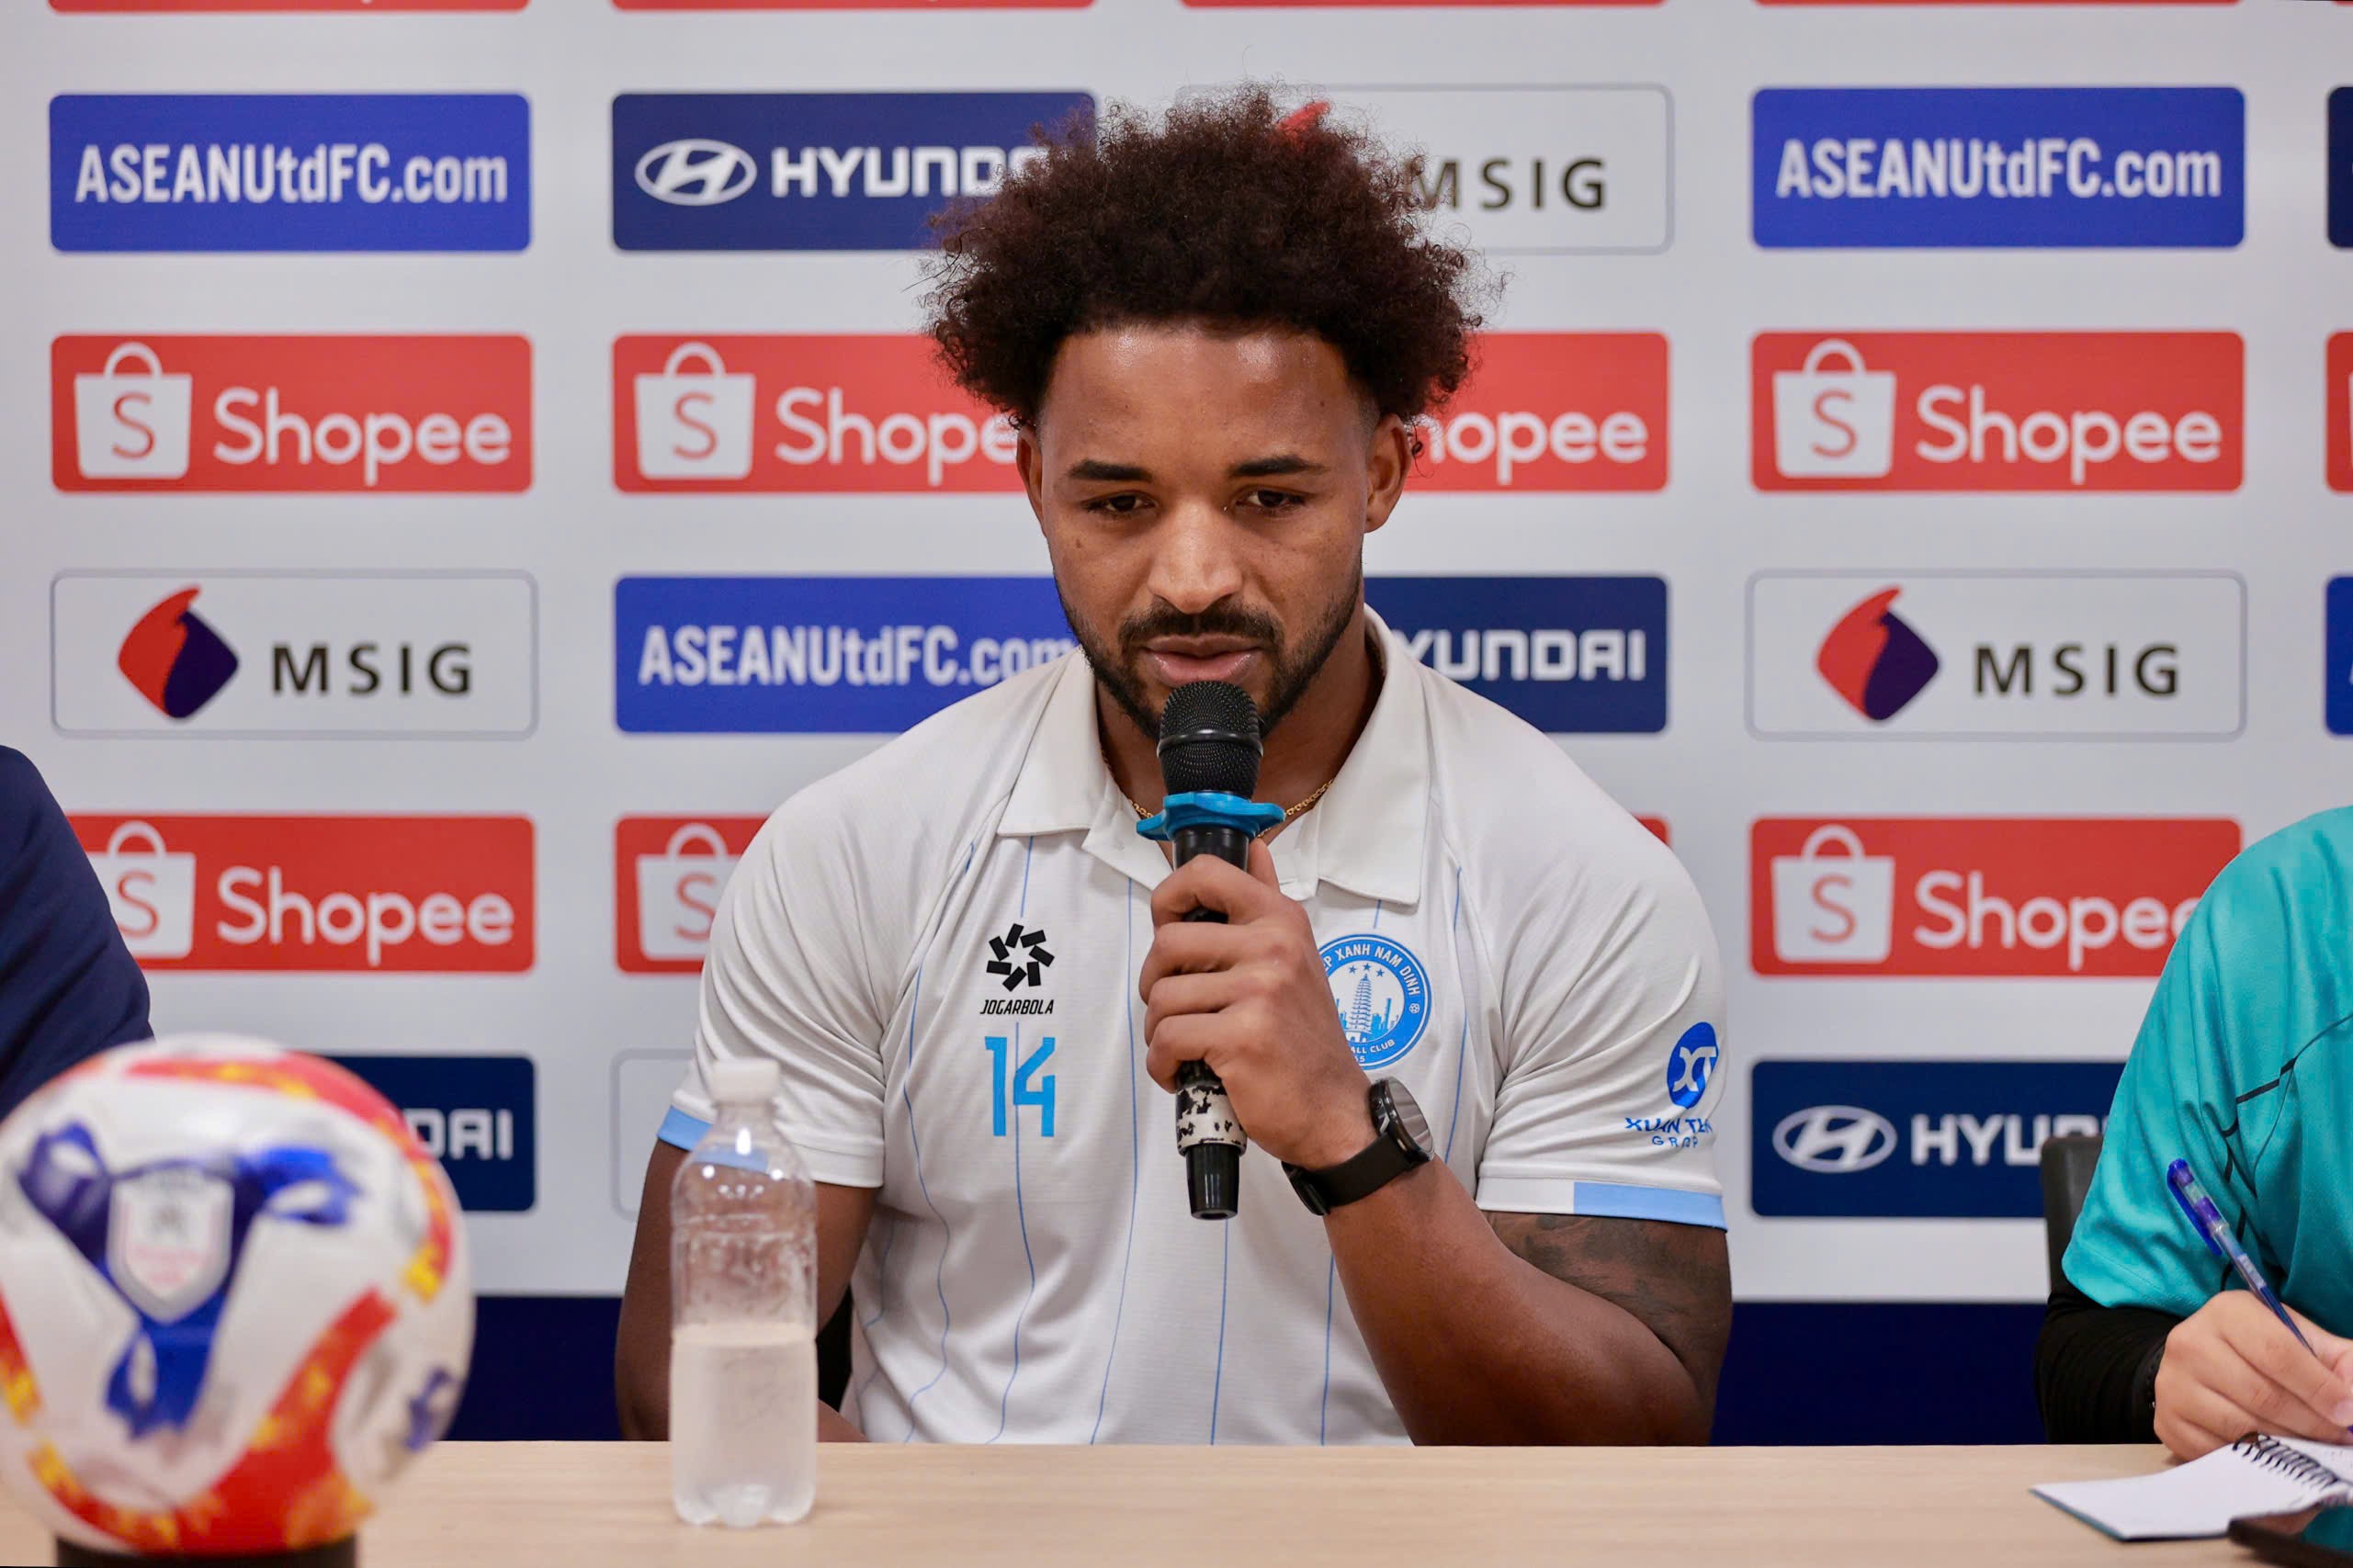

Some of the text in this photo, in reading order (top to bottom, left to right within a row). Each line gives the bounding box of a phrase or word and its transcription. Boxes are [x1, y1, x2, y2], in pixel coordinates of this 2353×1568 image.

[75, 143, 508, 204] ASEANUtdFC.com
[772, 146, 1052, 197] HYUND
[1775, 138, 2222, 199] ASEANUtdFC.com
[214, 387, 512, 487] Shopee
[775, 387, 1018, 486] Shope
[1916, 384, 2222, 485] Shopee
[272, 643, 471, 696] MSIG
[639, 625, 1076, 686] ASEANUtdFC.co
[1391, 628, 1646, 682] YUNDAI
[1974, 643, 2178, 698] MSIG
[217, 866, 515, 966] Shopee
[1334, 943, 1371, 962] XANH
[1374, 945, 1403, 968] NAM
[979, 998, 1055, 1015] JOGARBOLA
[1370, 1039, 1396, 1054] CLUB
[984, 1036, 1056, 1137] 14
